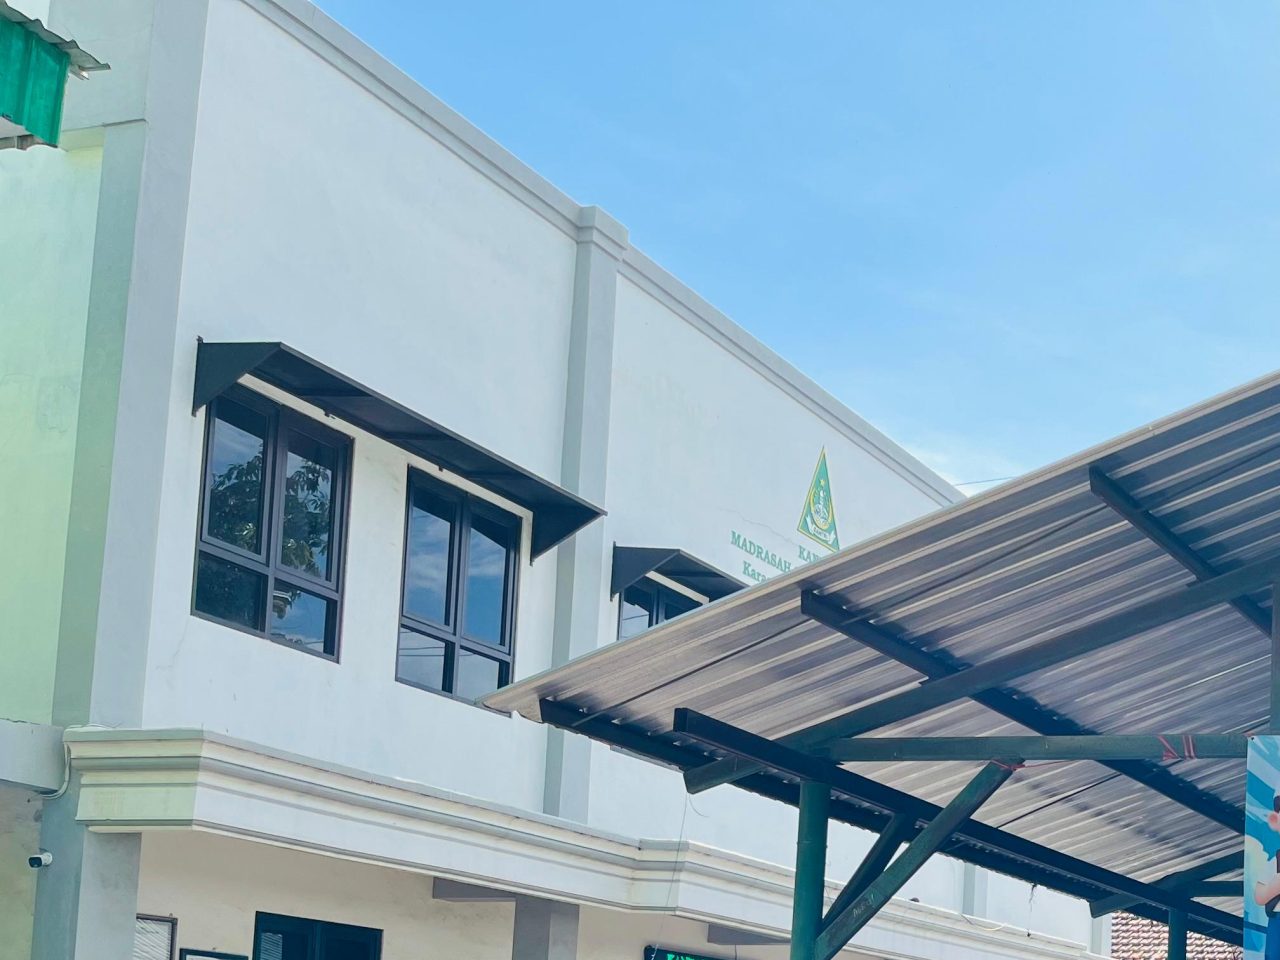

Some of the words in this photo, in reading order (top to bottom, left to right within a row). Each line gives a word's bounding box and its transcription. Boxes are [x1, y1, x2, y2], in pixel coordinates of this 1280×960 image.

[731, 530, 792, 574] MADRASAH
[798, 545, 821, 563] KAN
[743, 561, 769, 582] Kara
